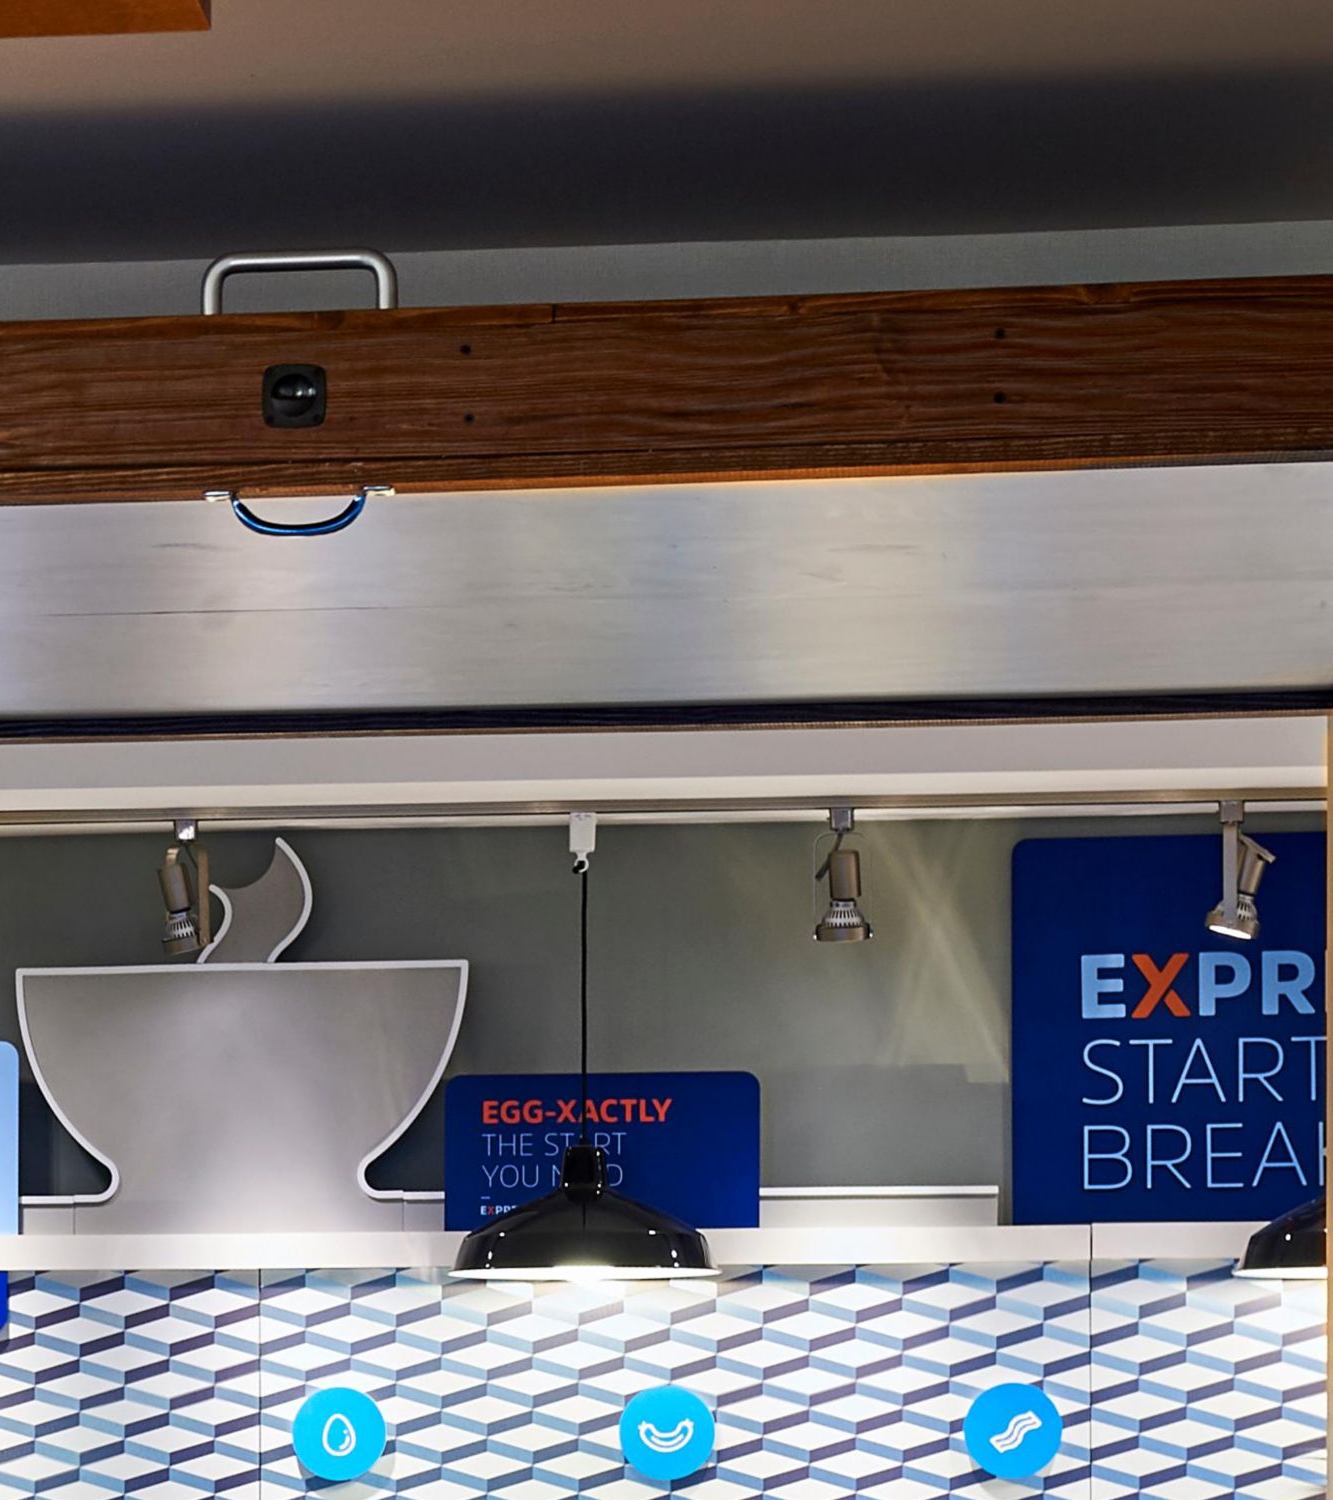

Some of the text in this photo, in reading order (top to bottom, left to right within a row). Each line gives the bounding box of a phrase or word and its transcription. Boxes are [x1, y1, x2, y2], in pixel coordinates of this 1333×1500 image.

[1080, 950, 1316, 1019] EXPR
[1082, 1036, 1327, 1105] START
[482, 1098, 673, 1125] EGG-XACTLY
[482, 1132, 627, 1157] THE STRT
[482, 1164, 539, 1188] YOU
